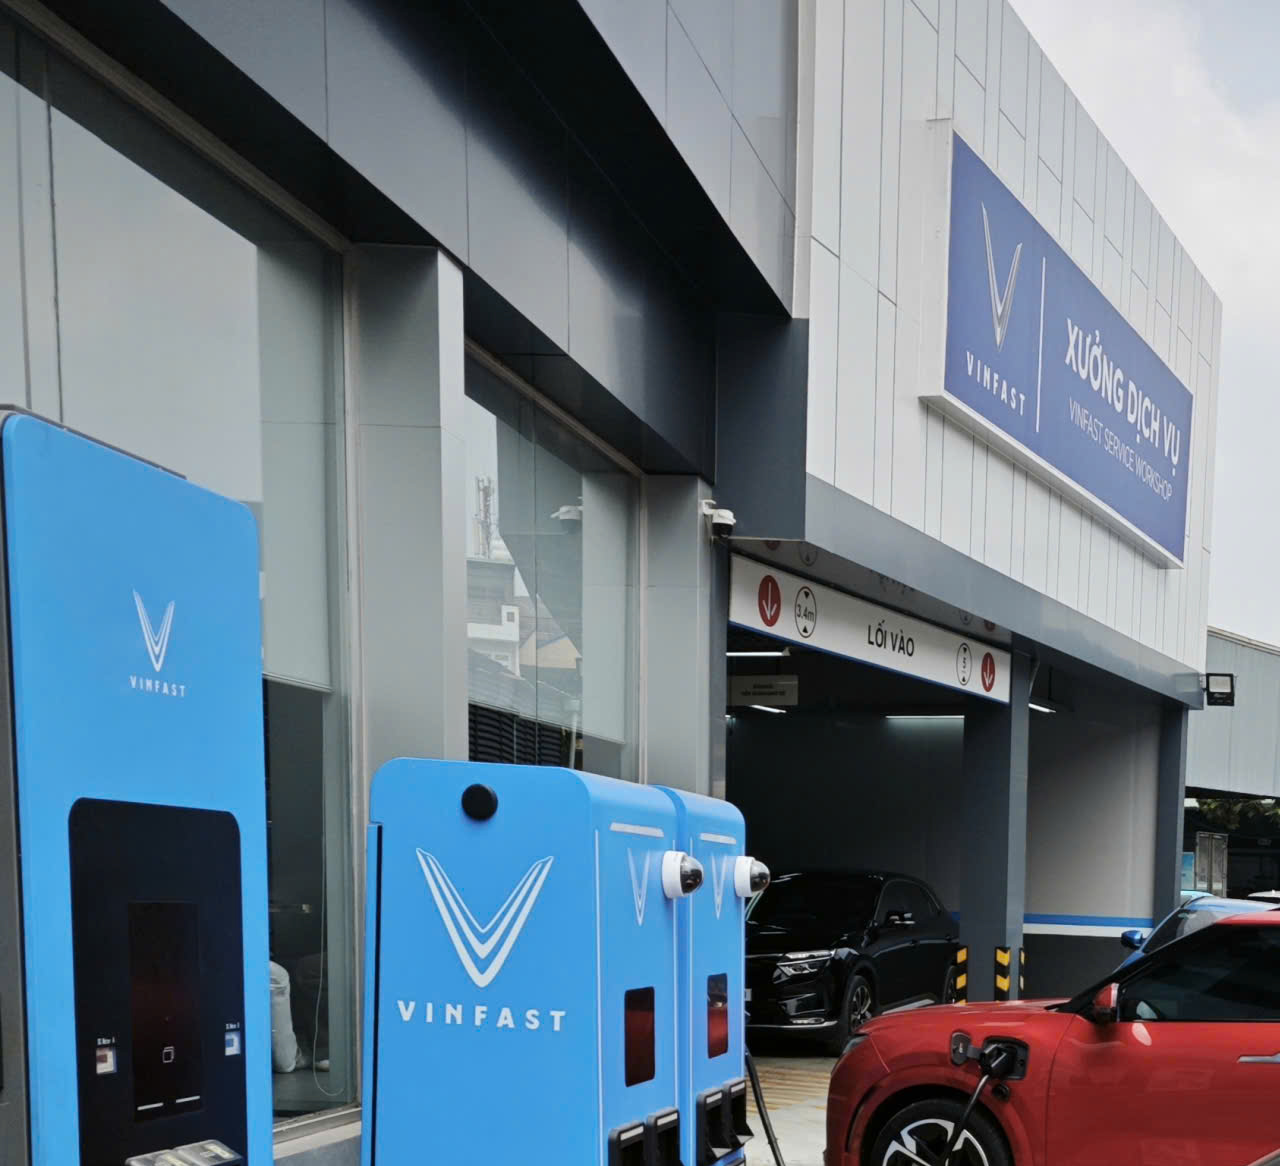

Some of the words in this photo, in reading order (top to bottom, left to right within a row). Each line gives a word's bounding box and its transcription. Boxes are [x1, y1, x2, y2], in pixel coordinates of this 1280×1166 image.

[966, 351, 1027, 416] VINFAST
[1065, 318, 1124, 413] XƯỞNG
[1127, 379, 1160, 448] DỊCH
[1162, 419, 1181, 477] VỤ
[1069, 397, 1103, 447] VINFAST
[1104, 429, 1135, 473] SERVICE
[1135, 458, 1173, 503] WORKSHOP
[867, 619, 887, 649] LỐI
[890, 631, 915, 657] VÀO
[129, 674, 186, 698] VINFAST
[397, 999, 567, 1032] VINFAST
